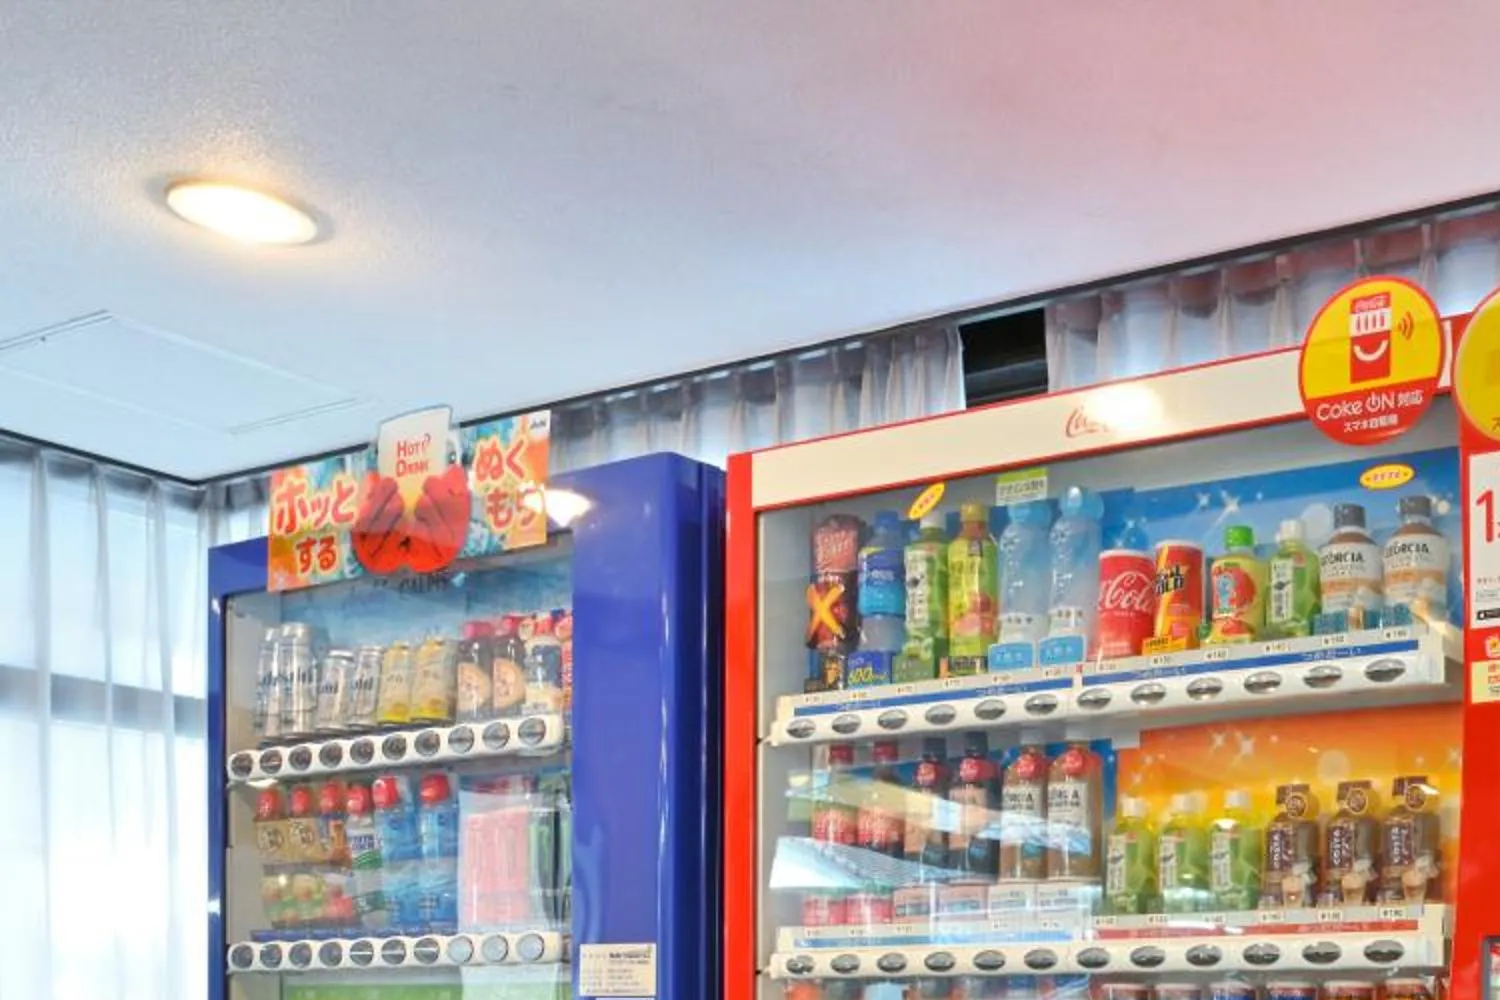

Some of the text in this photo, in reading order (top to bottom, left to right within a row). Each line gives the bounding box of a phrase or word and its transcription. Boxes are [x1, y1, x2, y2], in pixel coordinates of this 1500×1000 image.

[1316, 397, 1363, 421] Coke
[1366, 389, 1397, 413] ON
[475, 438, 526, 483] ぬく
[273, 473, 359, 535] ホッと
[295, 536, 339, 572] する
